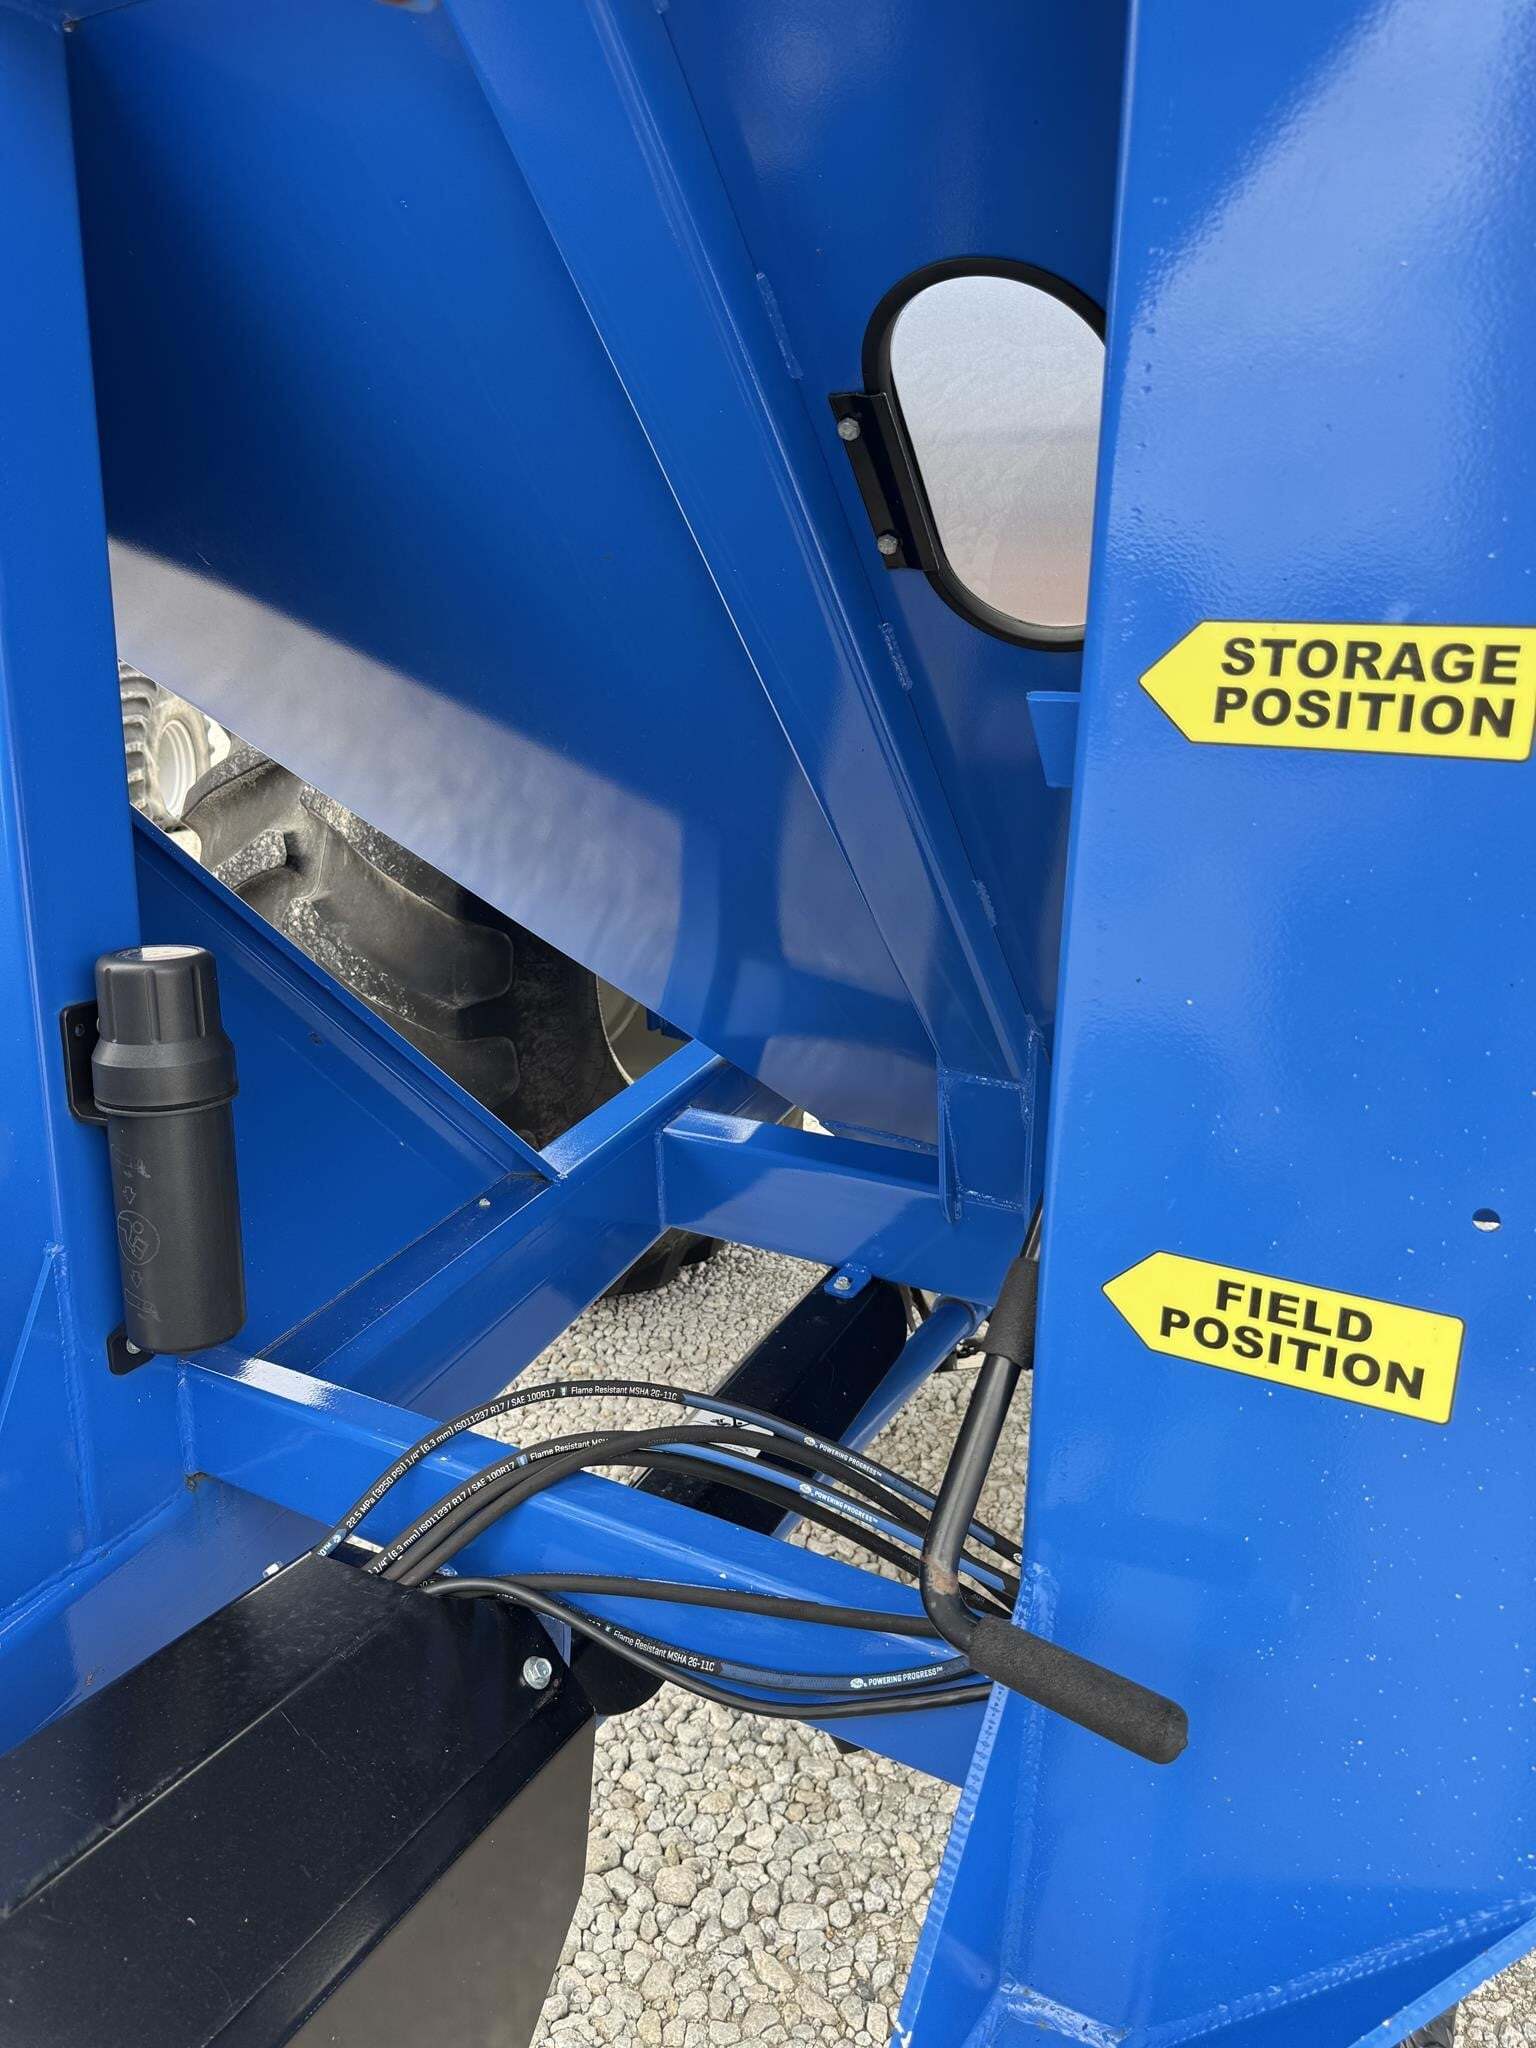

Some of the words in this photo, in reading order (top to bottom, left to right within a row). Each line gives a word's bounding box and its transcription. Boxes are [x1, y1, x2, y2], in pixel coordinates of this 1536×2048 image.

[1220, 636, 1522, 686] STORAGE
[1213, 686, 1516, 739] POSITION
[1215, 1278, 1373, 1343] FIELD
[1159, 1306, 1425, 1401] POSITION
[346, 1511, 363, 1529] 22.5
[359, 1497, 376, 1513] MPa
[372, 1476, 394, 1499] (3250
[391, 1462, 408, 1480] PSI)
[421, 1438, 437, 1454] (6.3
[435, 1426, 454, 1444] mm)
[490, 1402, 505, 1415] R17
[511, 1396, 525, 1408] SAE
[527, 1388, 556, 1403] 100R17
[571, 1386, 594, 1395] Flame
[594, 1385, 628, 1395] Resistant
[628, 1387, 649, 1397] MSHA
[819, 1443, 849, 1461] POWERING
[402, 1529, 421, 1549] mm)
[451, 1491, 467, 1506] R17
[471, 1477, 487, 1492] SAE
[487, 1461, 515, 1481] 100R17
[529, 1448, 554, 1461] Flame
[554, 1440, 590, 1454] Resistant
[814, 1490, 844, 1507] POWERING
[613, 1629, 634, 1646] Flame
[634, 1637, 667, 1659] Resistant
[666, 1649, 688, 1667] MSHA
[868, 1674, 902, 1686] POWERING
